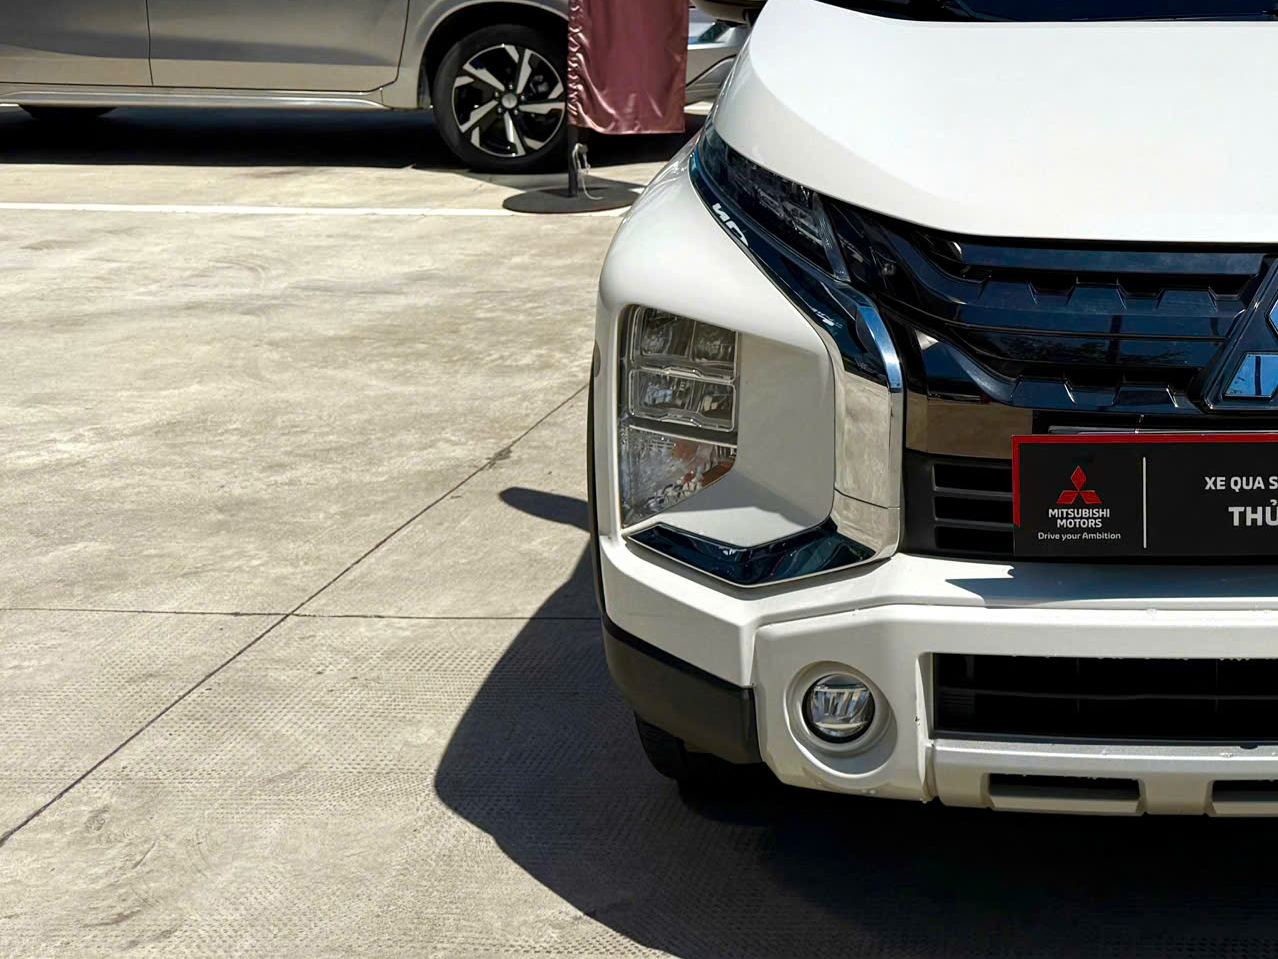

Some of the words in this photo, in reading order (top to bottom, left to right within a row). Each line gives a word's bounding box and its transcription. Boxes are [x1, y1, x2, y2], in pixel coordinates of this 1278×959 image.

[1204, 476, 1226, 490] XE
[1230, 476, 1265, 493] QUA
[1048, 508, 1110, 518] MITSUBISHI
[1056, 519, 1103, 528] MOTORS
[1038, 532, 1060, 540] Drive
[1082, 532, 1121, 540] Ambition
